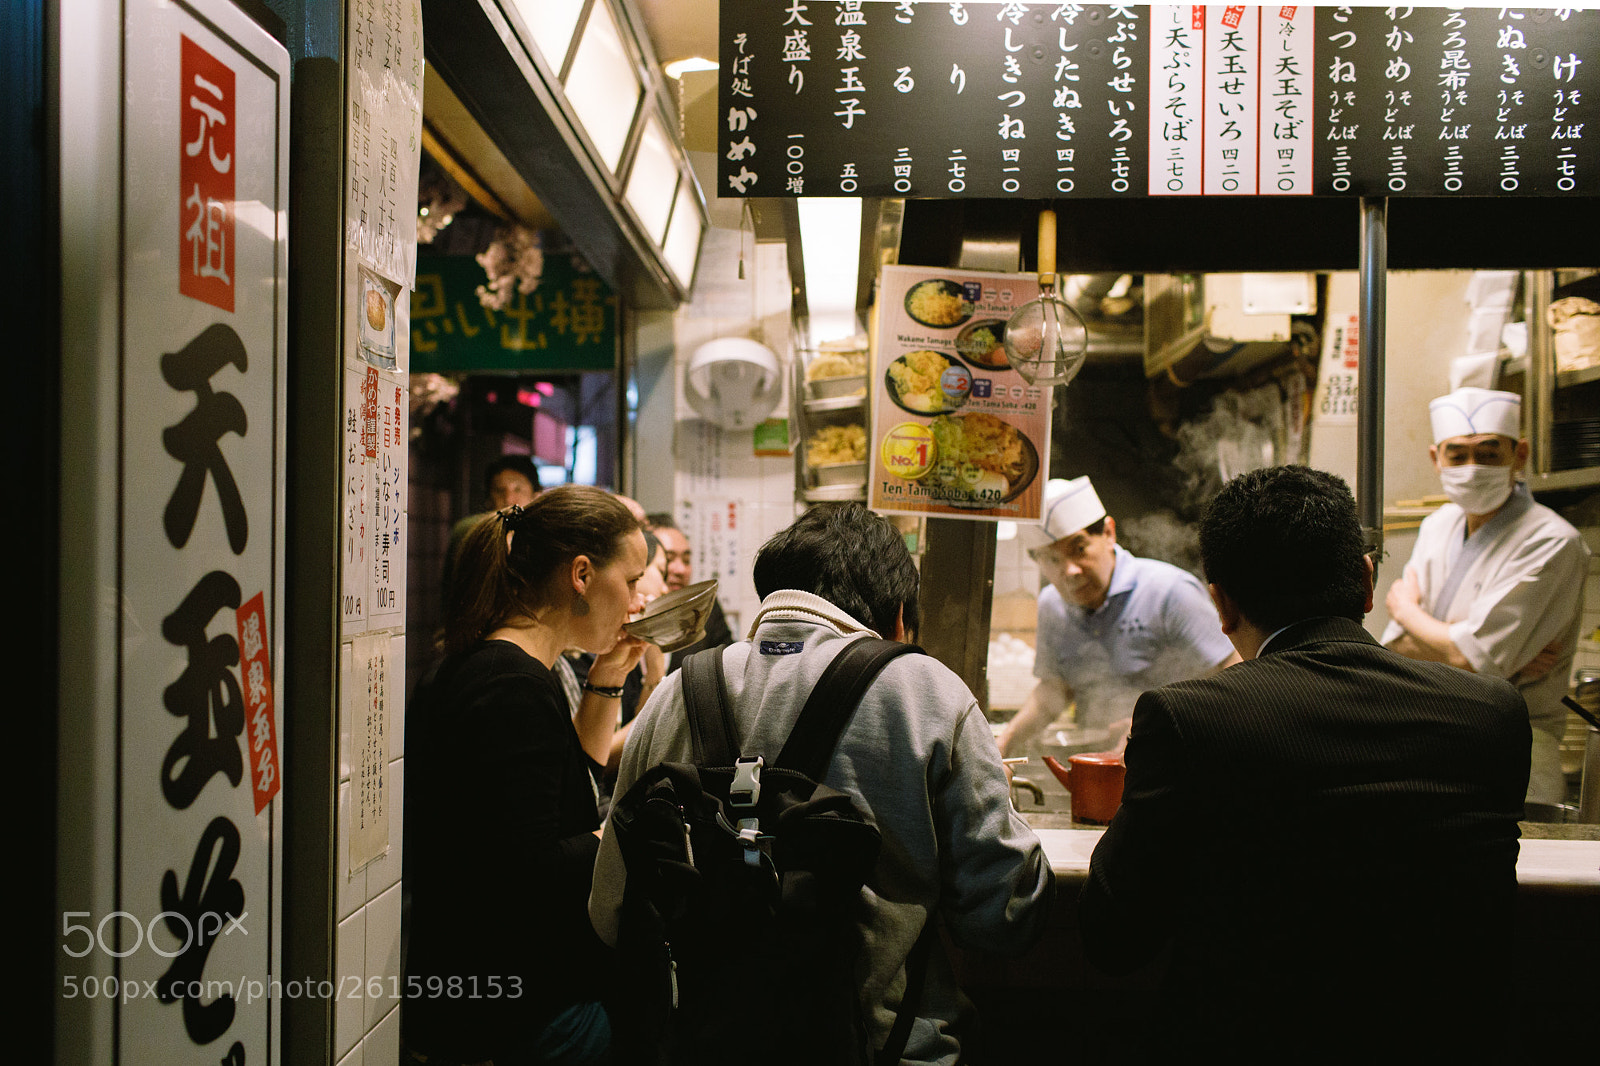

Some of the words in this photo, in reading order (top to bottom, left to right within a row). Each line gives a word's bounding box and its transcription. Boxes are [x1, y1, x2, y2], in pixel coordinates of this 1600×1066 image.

[732, 33, 755, 98] そば処
[781, 0, 813, 95] 大盛り
[834, 1, 867, 129] 温泉玉子
[996, 3, 1027, 140] 冷しきつね
[1050, 3, 1085, 141] 冷したぬき
[1217, 31, 1248, 142] 天玉せいろ
[1438, 7, 1472, 91] ろろ昆布
[185, 73, 231, 287] 元祖
[727, 106, 758, 194] かめや
